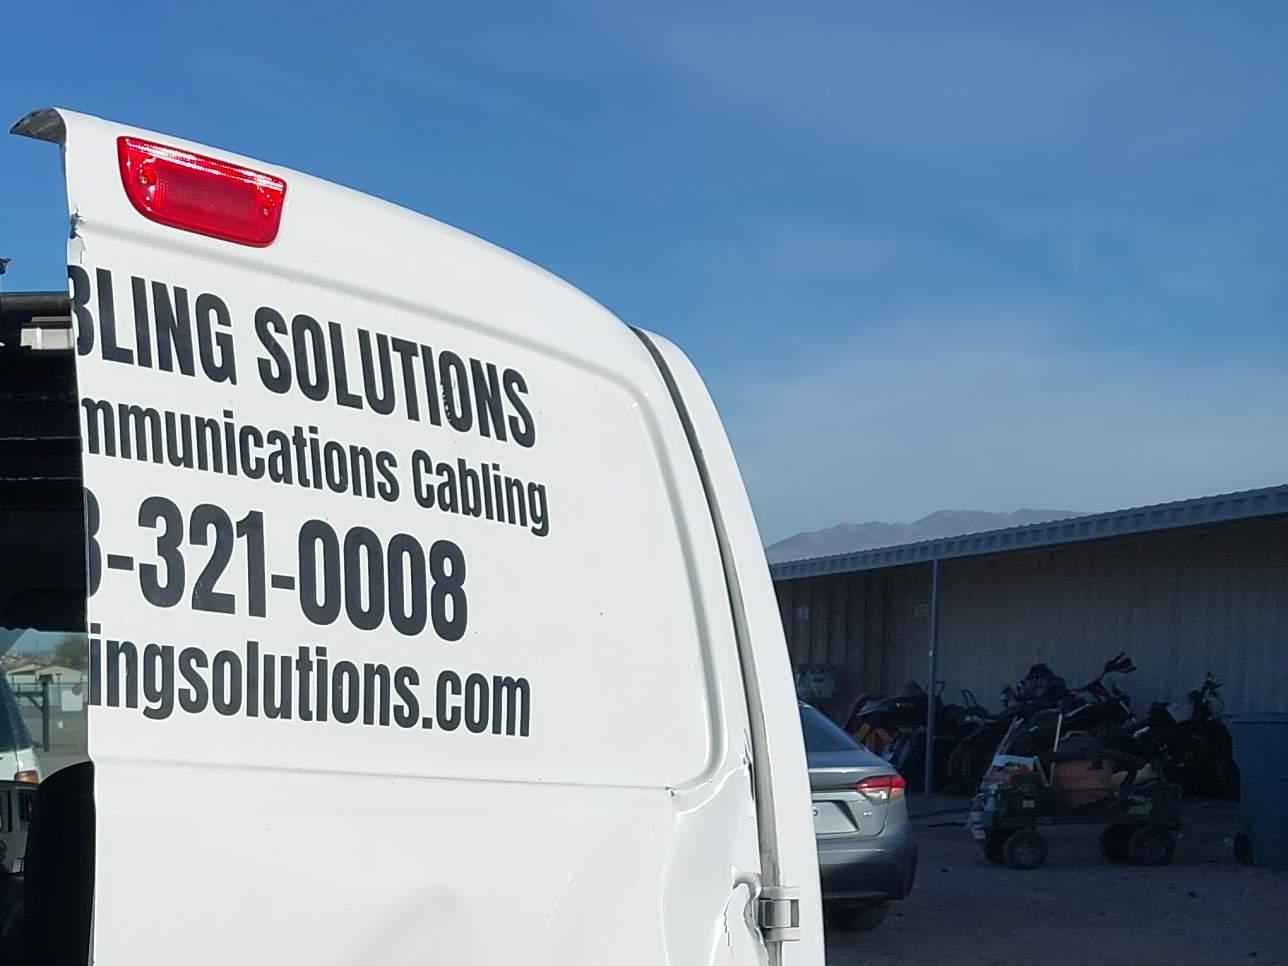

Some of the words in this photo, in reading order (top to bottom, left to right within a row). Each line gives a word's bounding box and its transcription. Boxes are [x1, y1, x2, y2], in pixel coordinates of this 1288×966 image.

[254, 306, 536, 448] SOLUTIONS
[412, 449, 549, 536] Cabling
[89, 623, 531, 736] ingsolutions.com
